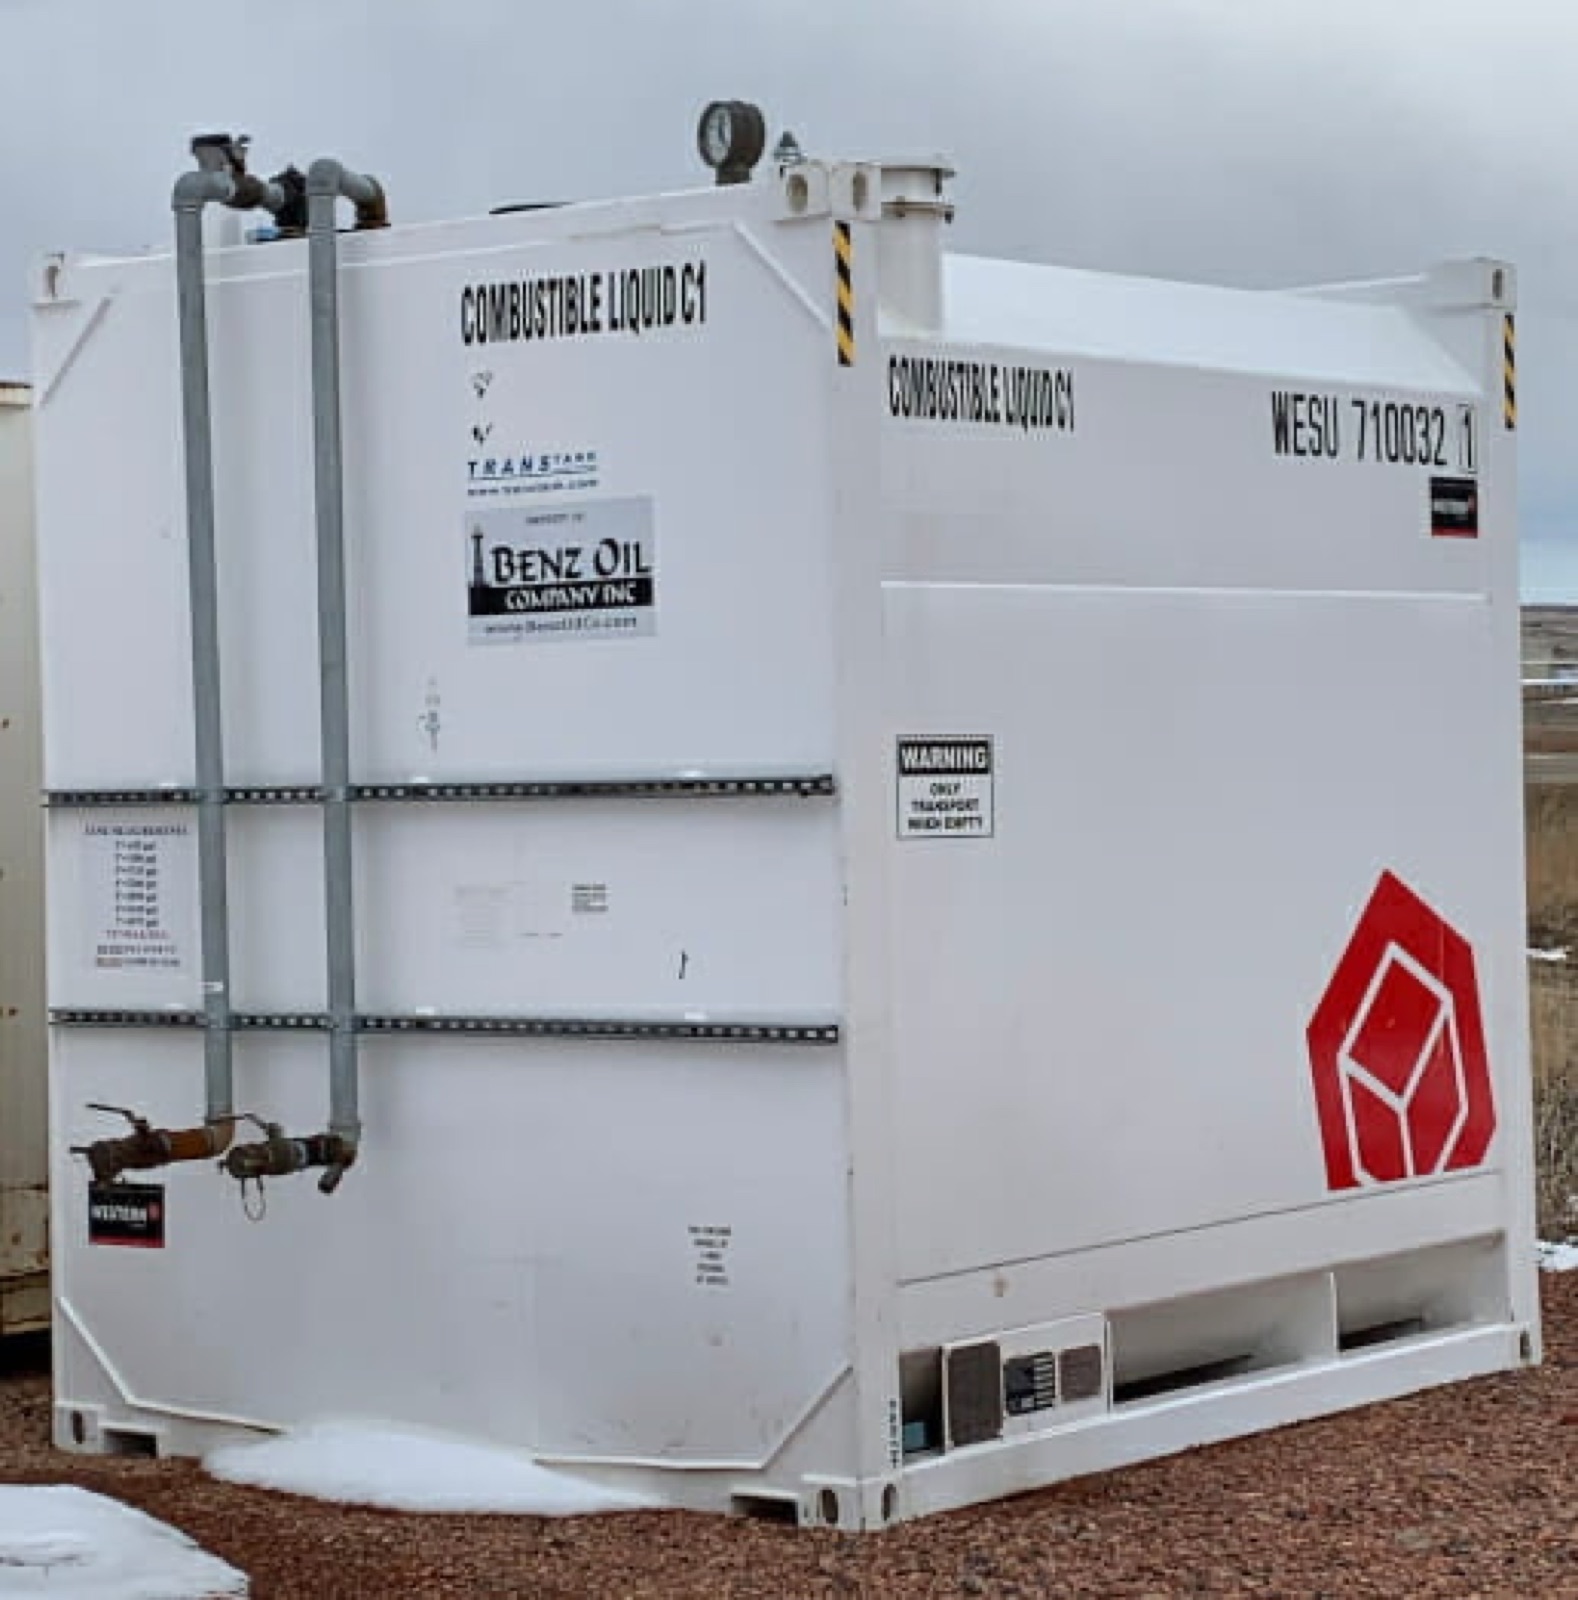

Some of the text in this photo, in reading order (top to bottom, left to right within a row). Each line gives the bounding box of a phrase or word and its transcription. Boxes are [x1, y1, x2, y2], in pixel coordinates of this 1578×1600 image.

[461, 259, 707, 346] COMBUSTIBLE LIQUID C1
[889, 354, 1075, 433] COMBUSTIBLE LIQUID C1
[1271, 390, 1340, 459] WESU
[1351, 399, 1448, 467] 710032
[504, 582, 637, 611] COMPANY INC
[901, 745, 987, 770] WARNING
